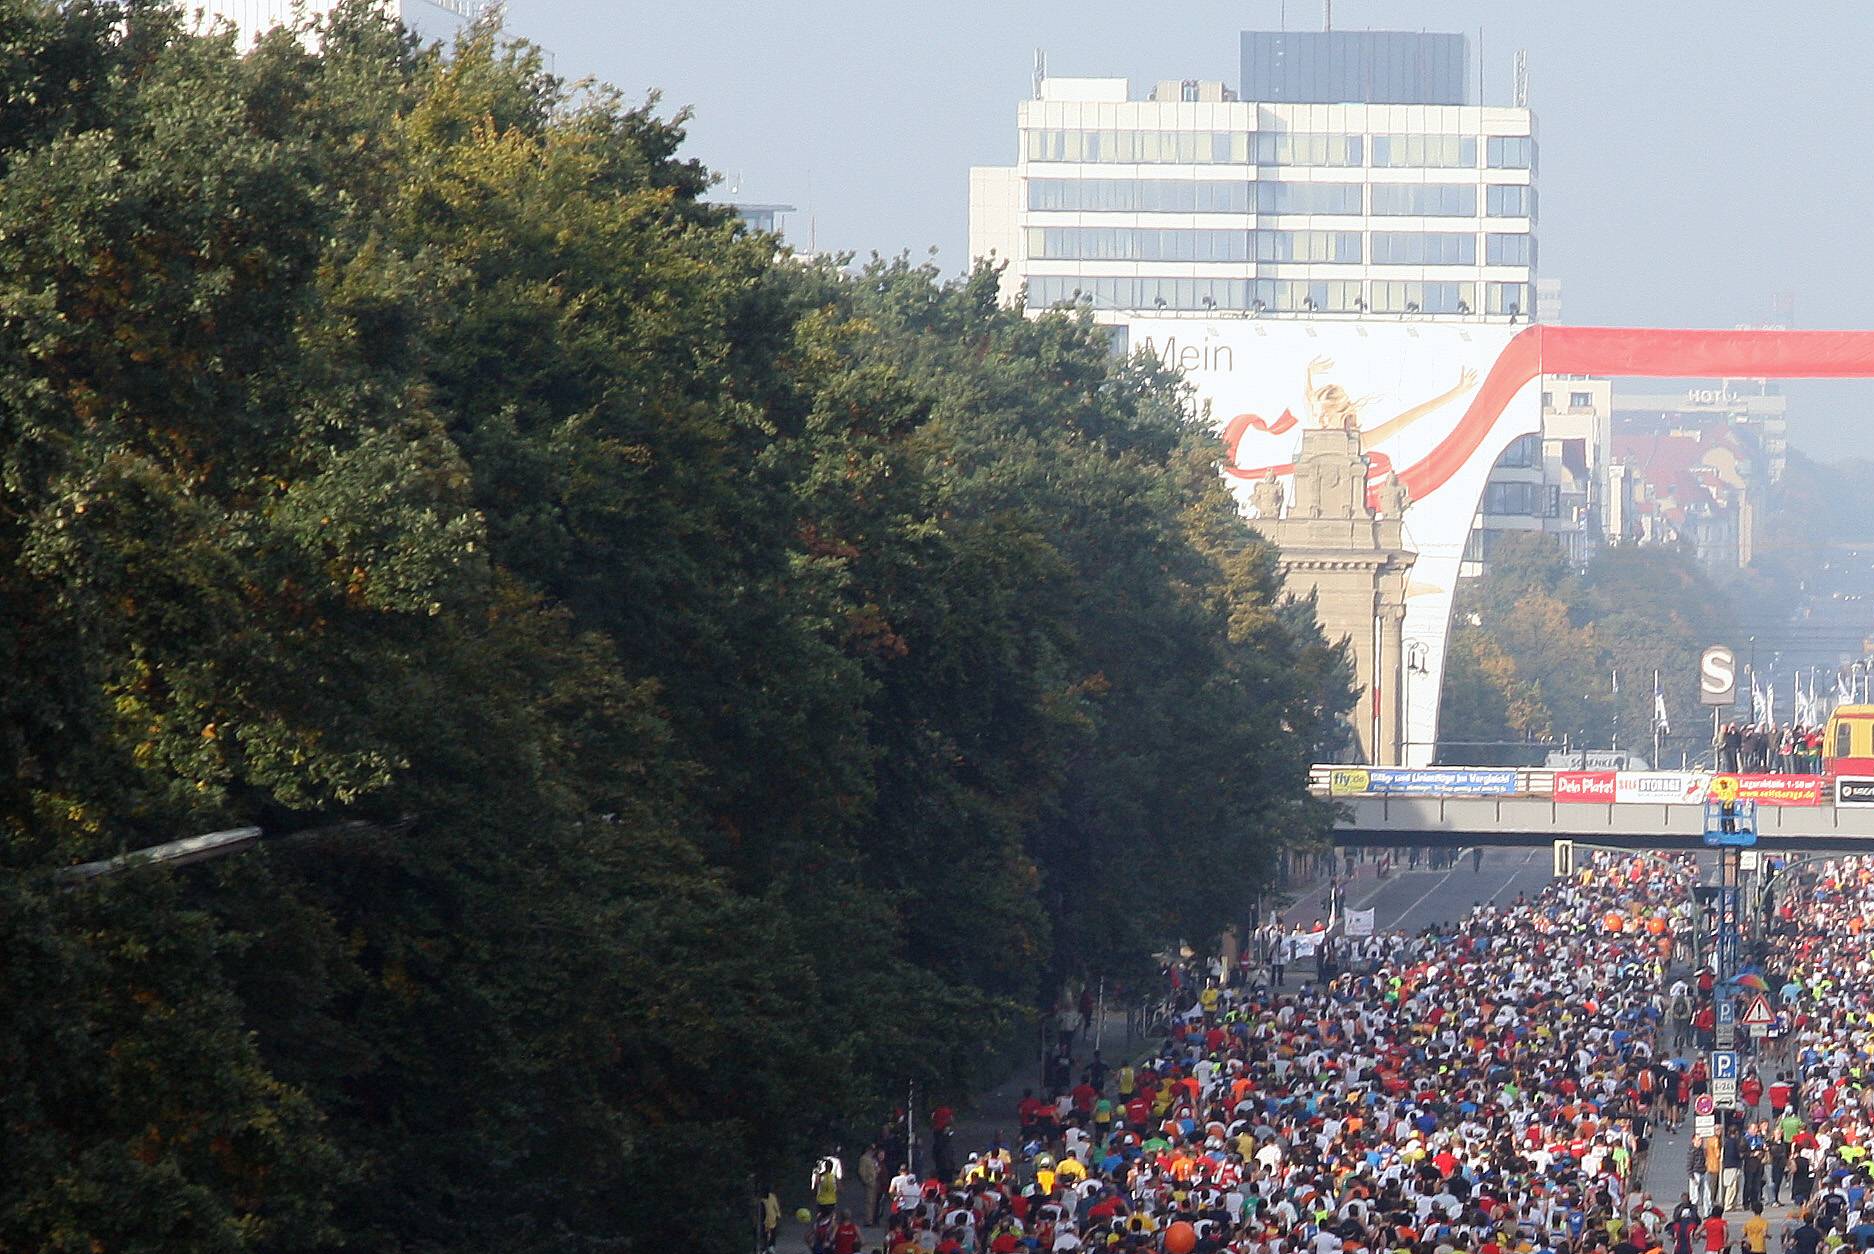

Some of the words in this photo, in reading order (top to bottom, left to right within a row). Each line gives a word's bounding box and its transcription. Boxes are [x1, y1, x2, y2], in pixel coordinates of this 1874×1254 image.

[1144, 335, 1233, 373] Mein
[1701, 650, 1734, 694] S
[1558, 777, 1581, 793] Dein
[1582, 777, 1616, 794] Platz!
[1639, 779, 1681, 791] STORAGE
[1717, 1054, 1731, 1078] P
